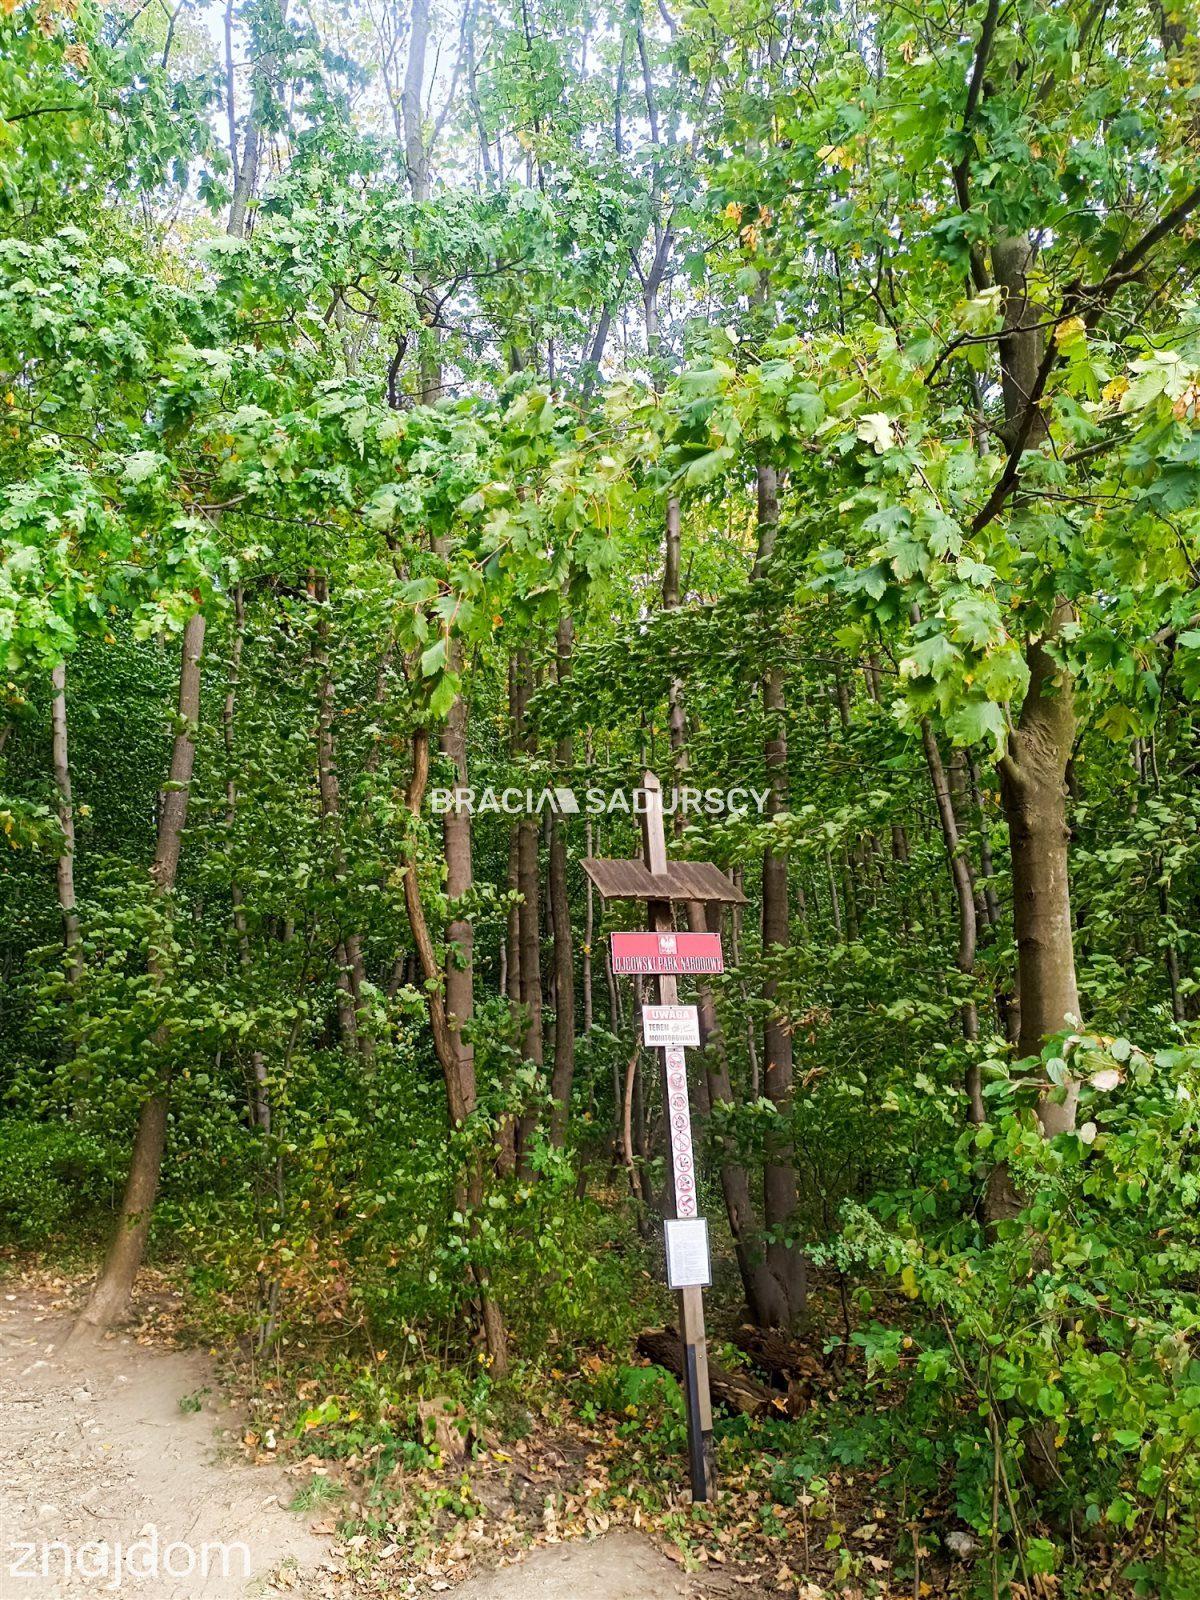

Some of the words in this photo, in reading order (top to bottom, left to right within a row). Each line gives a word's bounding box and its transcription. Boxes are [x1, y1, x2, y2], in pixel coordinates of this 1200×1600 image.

[615, 956, 657, 971] OJCOWSKI
[659, 957, 679, 970] PARK
[681, 957, 722, 971] NARODOWY
[651, 1009, 690, 1019] UWAGA
[648, 1023, 669, 1031] TEREN
